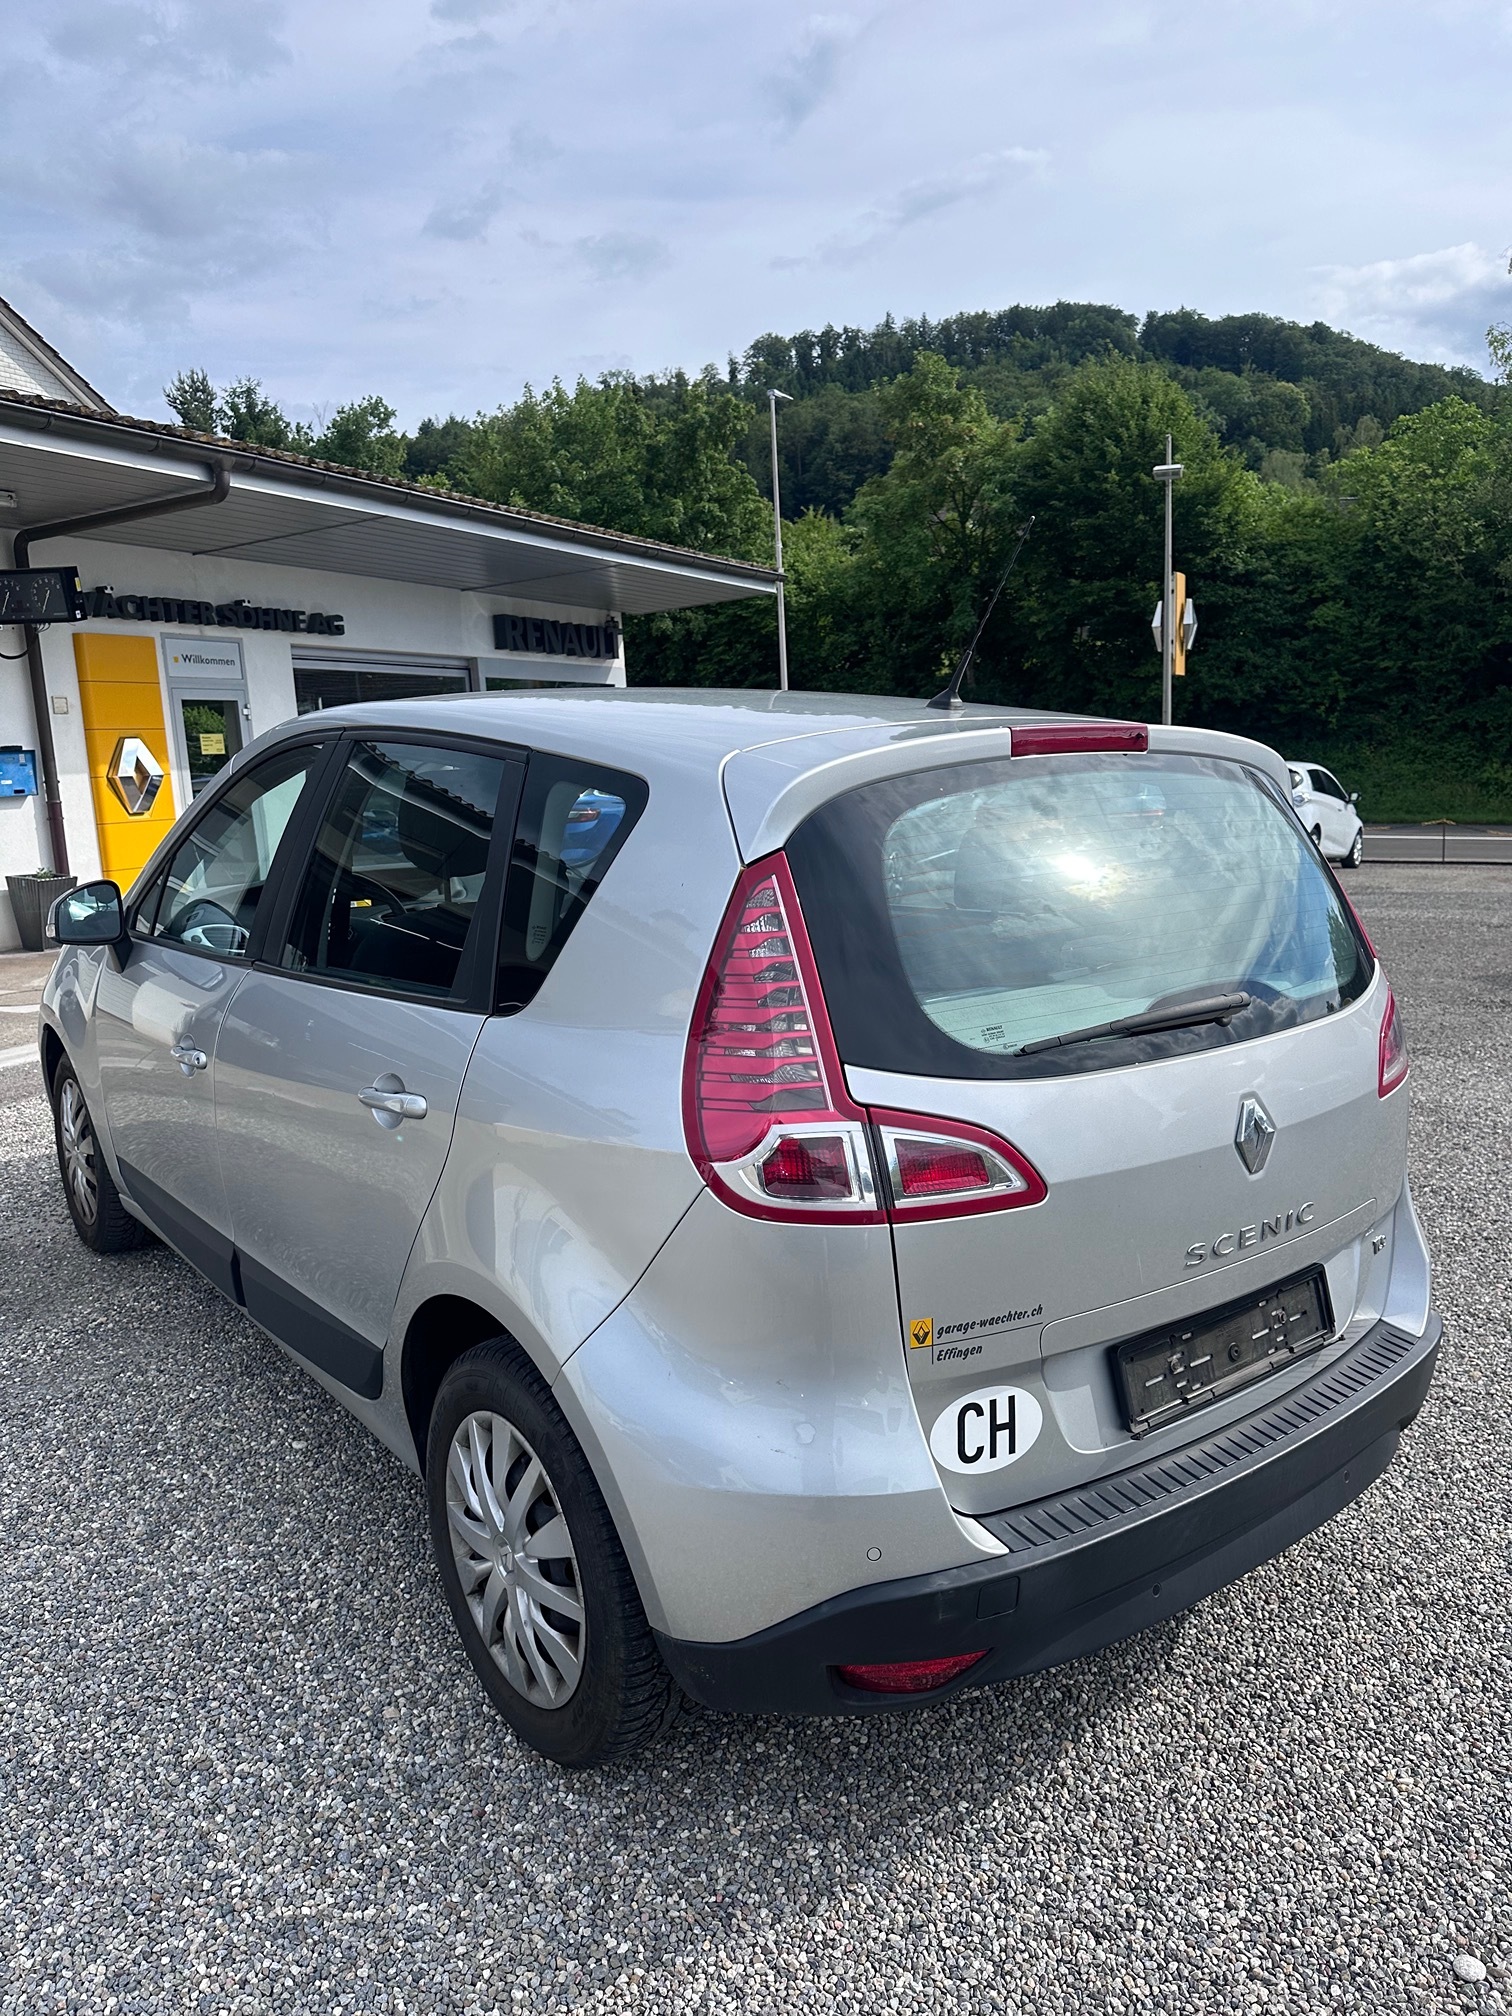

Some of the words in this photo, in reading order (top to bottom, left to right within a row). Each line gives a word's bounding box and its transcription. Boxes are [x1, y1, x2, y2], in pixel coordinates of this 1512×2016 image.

[215, 599, 306, 632] SÖHNE
[307, 612, 345, 635] AG
[493, 614, 619, 659] RENAULT
[181, 653, 235, 666] Willkommen
[1185, 1201, 1314, 1266] SCENIC
[937, 1304, 1043, 1339] garage-waechter.ch
[937, 1345, 983, 1361] Effingen
[957, 1395, 1016, 1464] CH
